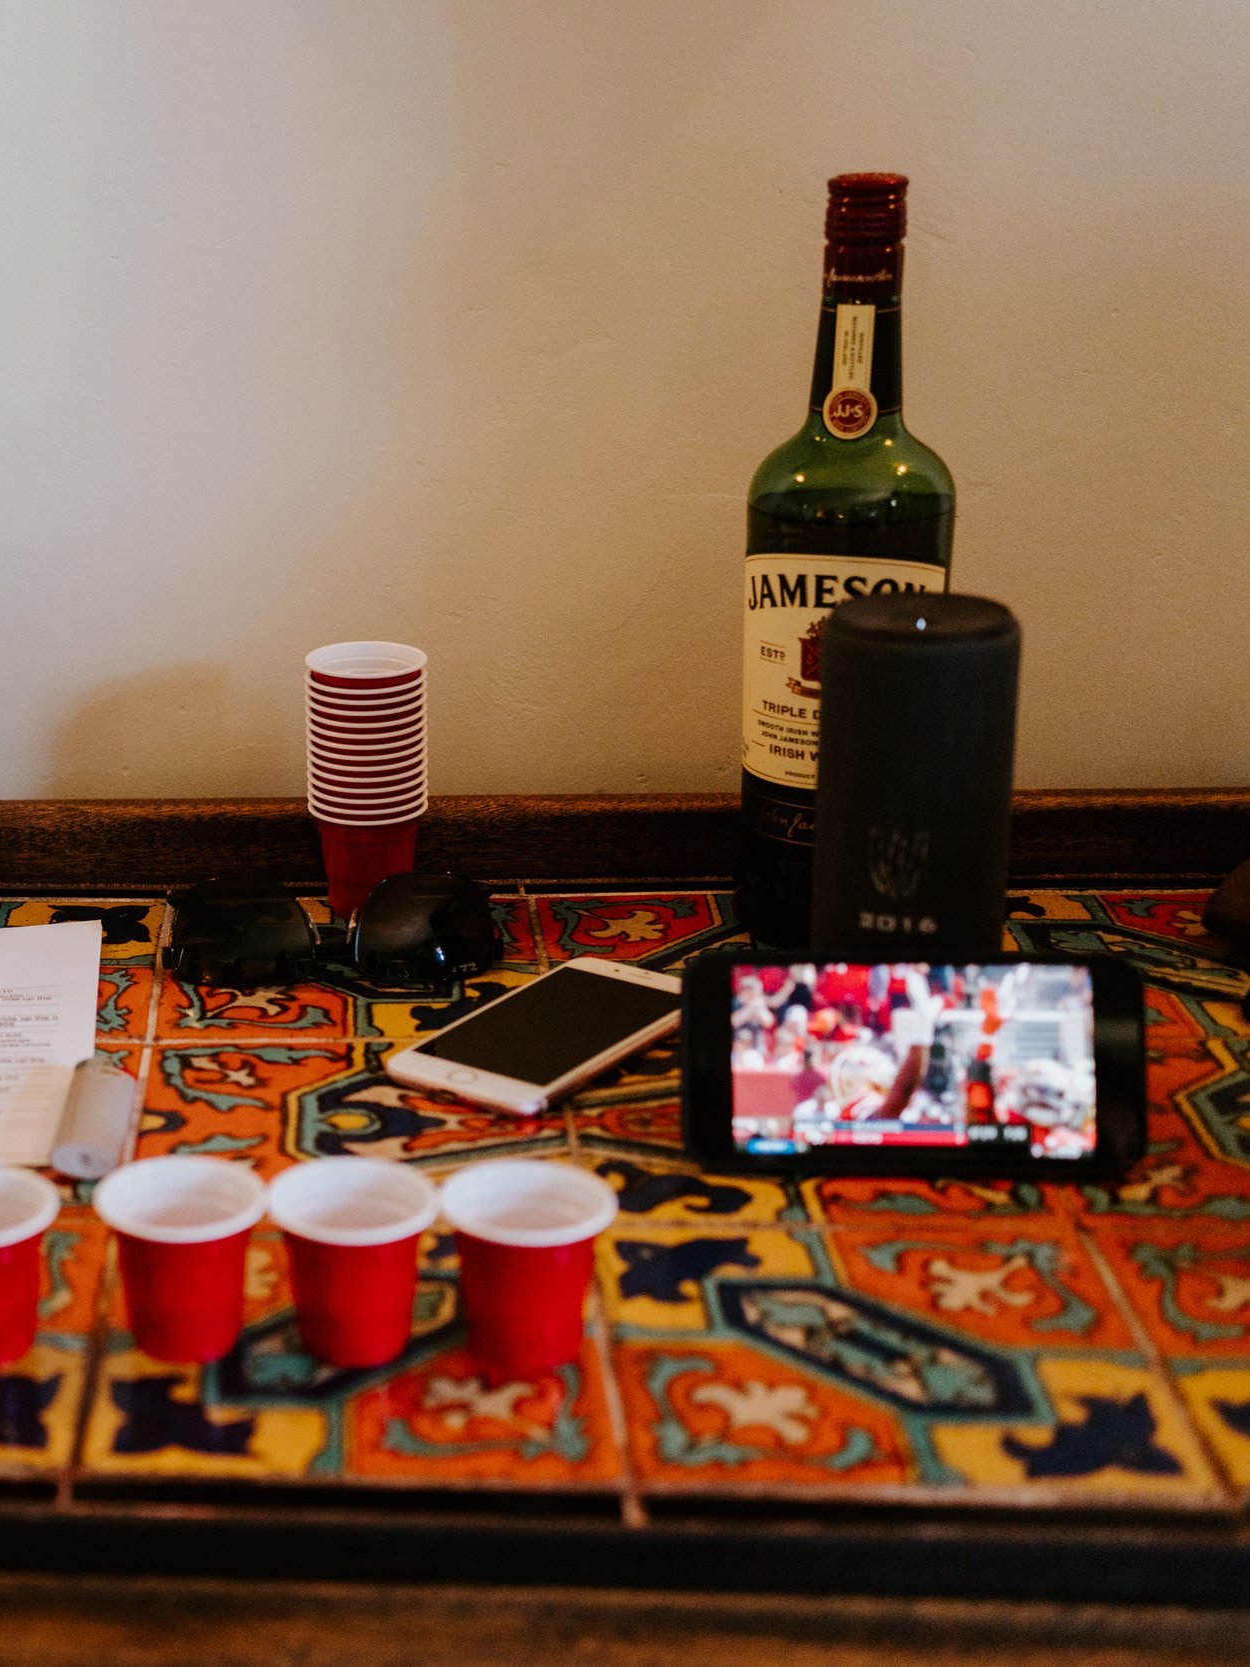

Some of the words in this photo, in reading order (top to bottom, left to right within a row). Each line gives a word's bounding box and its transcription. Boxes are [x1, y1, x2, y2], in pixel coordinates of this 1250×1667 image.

[762, 700, 807, 719] TRIPLE
[758, 719, 784, 732] SMOOTH
[786, 727, 809, 736] IRISH
[761, 730, 778, 740] JOHN
[779, 734, 819, 746] JAMESON
[769, 744, 805, 760] IRISH
[784, 771, 816, 780] PRODUCT
